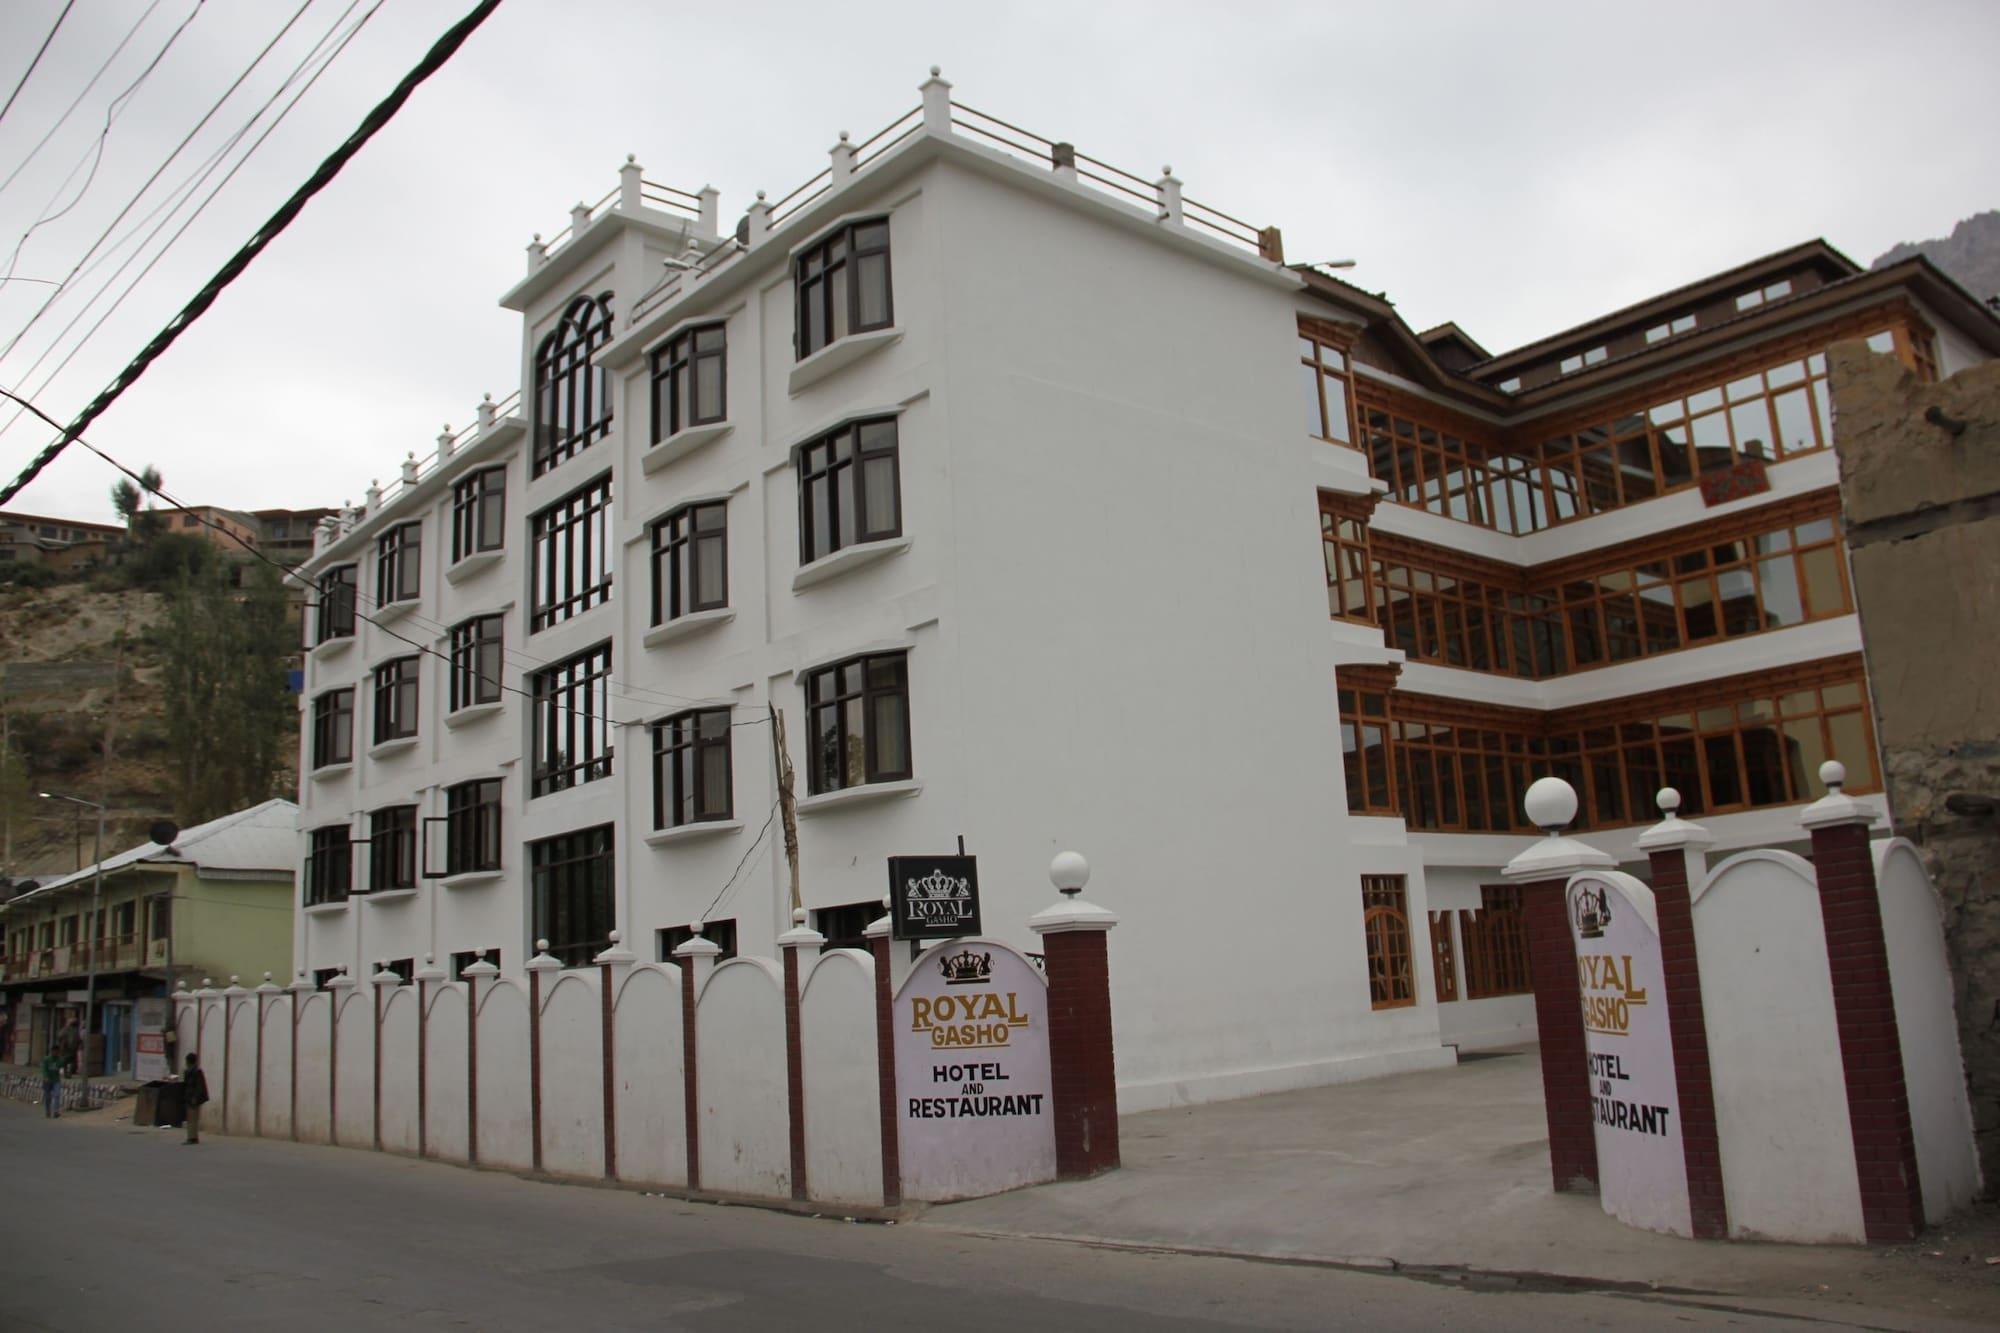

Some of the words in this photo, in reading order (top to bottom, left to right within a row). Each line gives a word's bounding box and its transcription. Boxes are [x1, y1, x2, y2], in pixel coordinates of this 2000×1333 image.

[908, 900, 973, 917] ROYAL
[1579, 954, 1646, 1000] OYAL
[911, 992, 1028, 1028] ROYAL
[931, 1023, 1009, 1046] GASHO
[932, 1062, 1010, 1082] HOTEL
[961, 1083, 984, 1095] AND
[909, 1094, 1043, 1118] RESTAURANT
[1591, 1096, 1669, 1137] TAURANT
